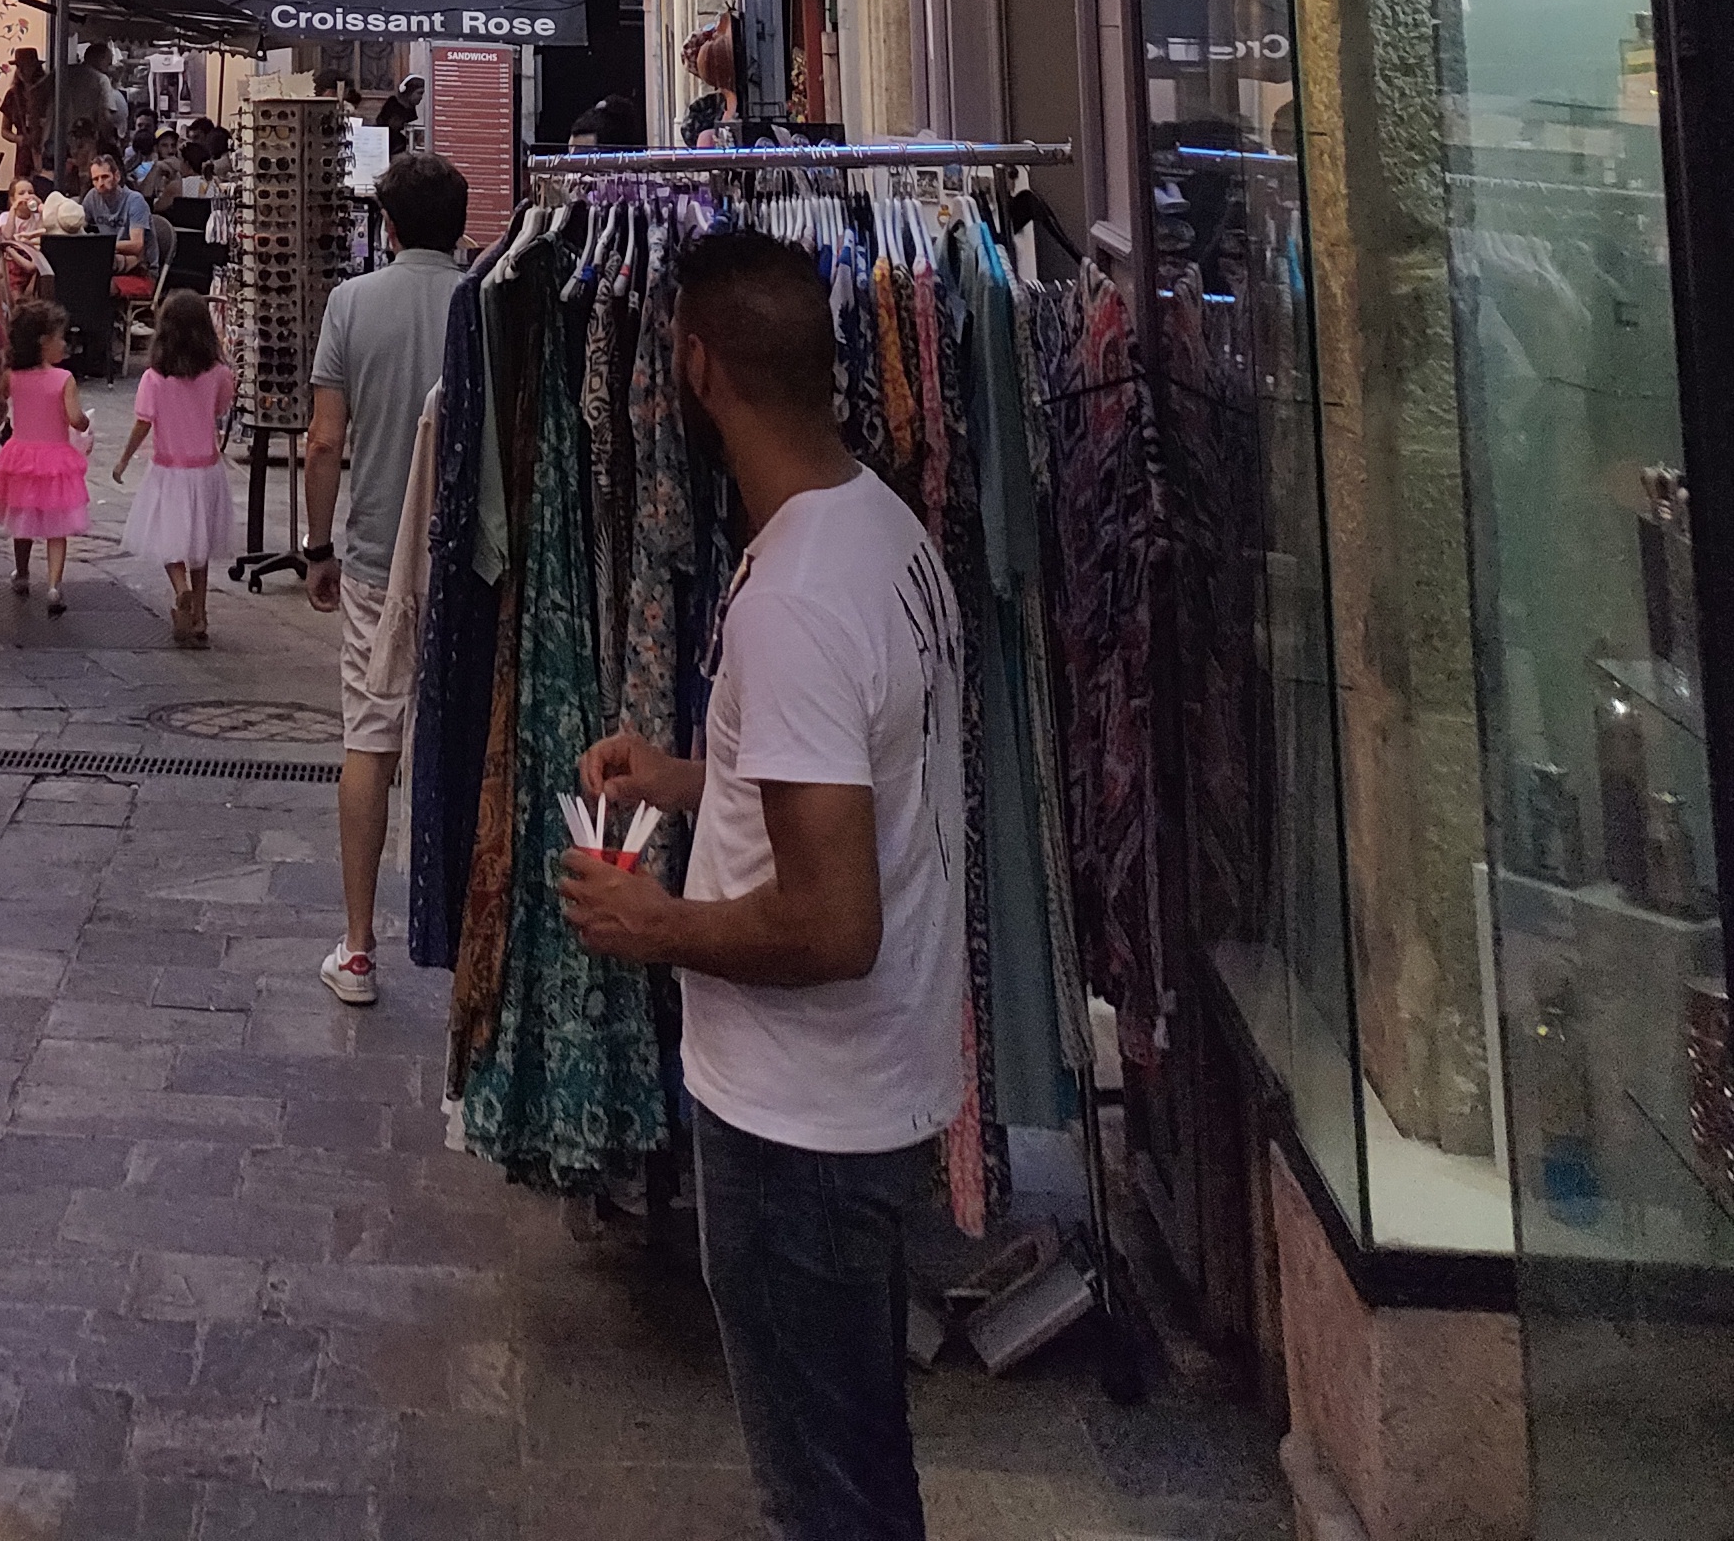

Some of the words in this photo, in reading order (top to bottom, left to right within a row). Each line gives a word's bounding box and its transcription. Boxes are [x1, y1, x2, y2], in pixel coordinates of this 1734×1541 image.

[271, 5, 445, 33] Croissant
[462, 11, 556, 37] Rose
[447, 51, 498, 62] SANDWICHS
